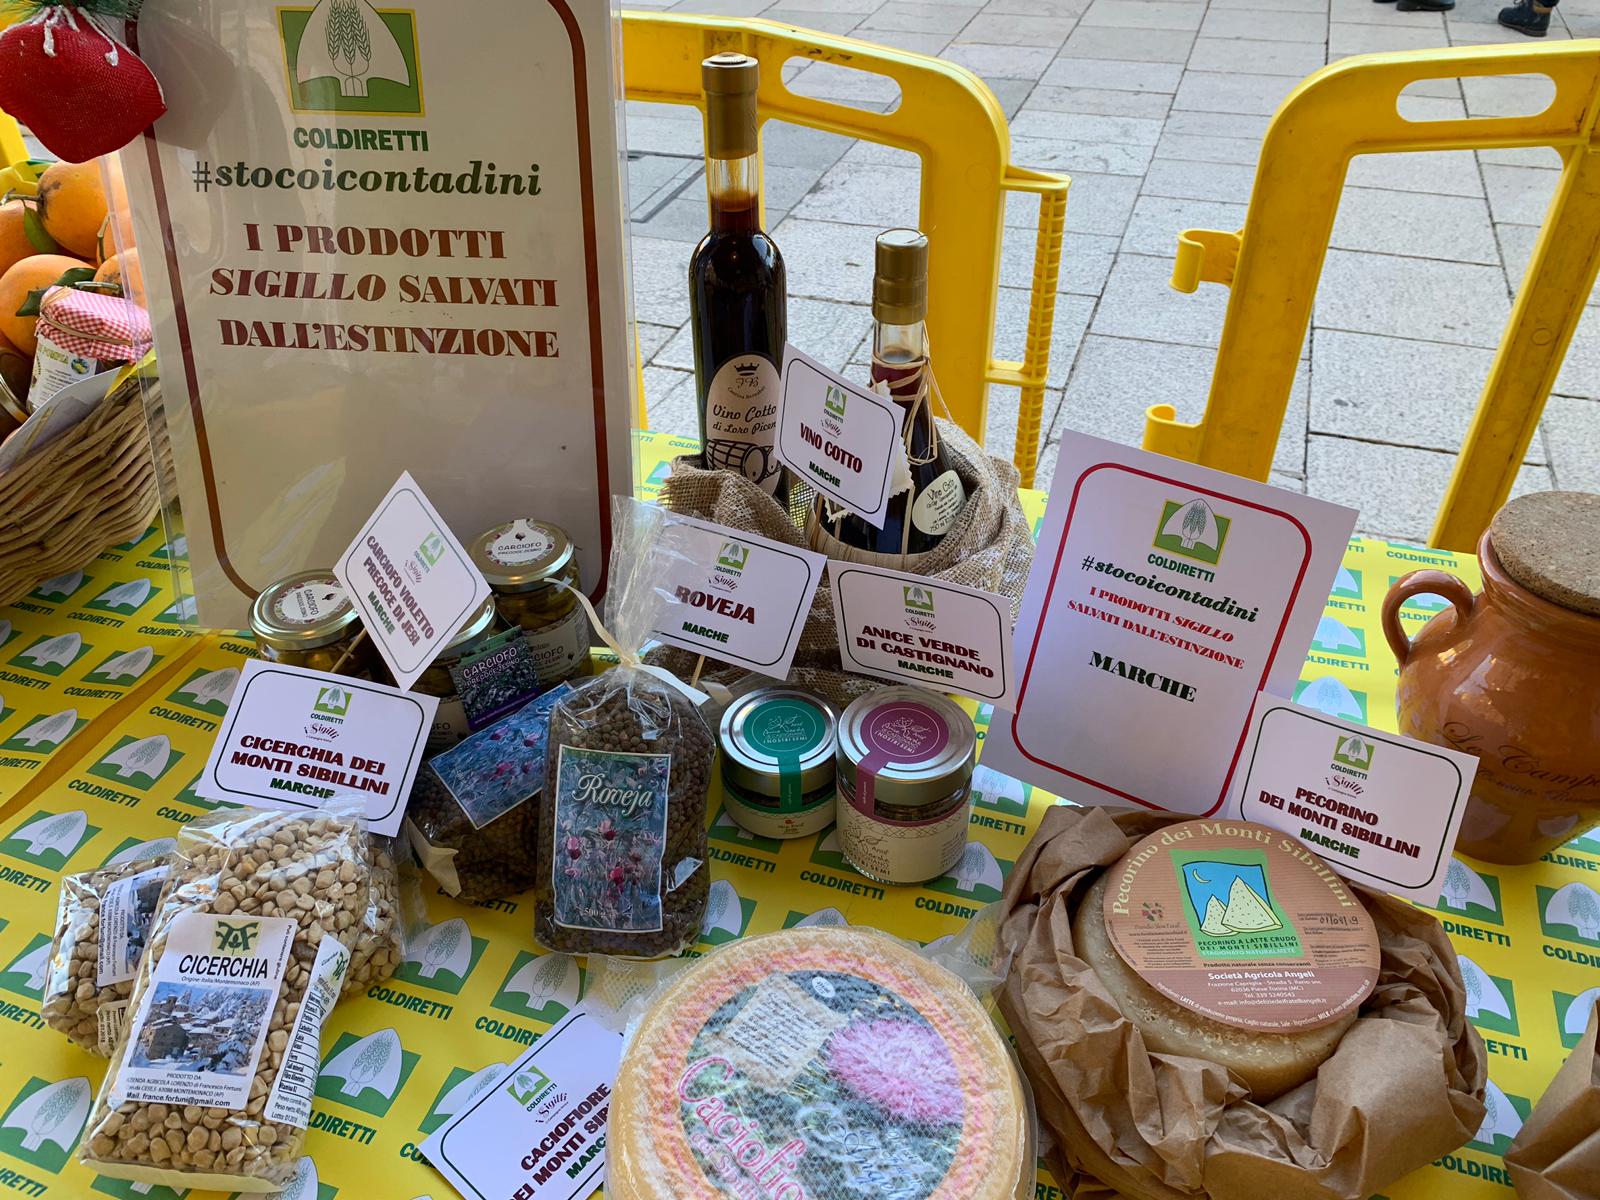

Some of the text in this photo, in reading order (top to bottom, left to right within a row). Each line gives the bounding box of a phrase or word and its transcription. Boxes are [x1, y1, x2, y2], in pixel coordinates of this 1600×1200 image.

[293, 126, 430, 152] COLDIRETTI
[192, 157, 543, 197] #stocoicontadini
[243, 223, 508, 260] I PRODOTTI
[209, 267, 560, 308] SIGILLO SALVATI
[217, 318, 560, 358] DALL'ESTINZIONE
[712, 421, 777, 435] di Loro Picen
[713, 404, 776, 423] Vino Cotto
[800, 422, 864, 475] VINO COTTO
[808, 460, 841, 488] MARCHE
[498, 541, 542, 551] CARCIOFO
[1386, 550, 1458, 569] COLDIRETTI
[1146, 552, 1216, 584] COLDIRETTI
[363, 555, 421, 647] PRECOCE DI JESI
[366, 534, 435, 640] CARCIOFO VIOLETTO
[1081, 555, 1260, 624] #stocoicontadini
[66, 611, 125, 629] COLDIRETTI
[367, 590, 396, 635] MARCHE
[673, 584, 757, 625] ROVEJA
[905, 607, 936, 618] COLDIRETTI
[1089, 586, 1235, 643] I PRODOTTI SIGILLO
[137, 625, 194, 638] COLDIRETTI
[681, 620, 730, 644] MARCHE
[862, 625, 981, 662] ANICE VERDE
[1067, 600, 1246, 670] SALVATI DALL'ESTINZIONE
[463, 647, 518, 679] CARCIOFO
[856, 637, 995, 679] DI CASTIGNANO
[897, 659, 955, 679] MARCHE
[1088, 650, 1198, 703] MARCHE
[63, 686, 124, 701] COLDIRETTI
[149, 706, 218, 732] COLDIRETTI
[310, 713, 344, 725] COLDIRETTI
[310, 722, 339, 739] Sigilli
[240, 734, 386, 776] CICERCHIA DEI
[231, 751, 391, 795] MONTI SIBILLINI
[1330, 763, 1368, 780] COLDIRETTI
[1333, 774, 1364, 795] Sigilli
[68, 778, 141, 808] COLDIRETTI
[269, 778, 336, 799] MARCHE
[571, 773, 654, 816] Roveja
[1295, 786, 1379, 826] PECORINO
[1258, 790, 1421, 859] DEI MONTI SIBILLINI
[1299, 828, 1361, 859] MARCHE
[800, 870, 885, 901] COLDIRETTI
[1112, 823, 1357, 918] Pecorino dei Monti Sibillini
[1198, 938, 1237, 946] PECORINO
[1245, 936, 1268, 944] LATTE
[1270, 935, 1297, 943] CRUDO
[1254, 941, 1299, 949] SIBILLINI
[178, 954, 269, 979] CICERCHIA
[1207, 970, 1315, 981] Società Agricola Angeli
[367, 985, 454, 1021] COLDIRETTI
[166, 1072, 193, 1080] PRODOTTO
[173, 1088, 214, 1097] MONTEMONACO
[526, 1082, 558, 1112] COLDIRETTI
[538, 1093, 567, 1118] Sigilli
[521, 1083, 611, 1171] CACIOFIORE
[533, 1132, 586, 1186] MONTI
